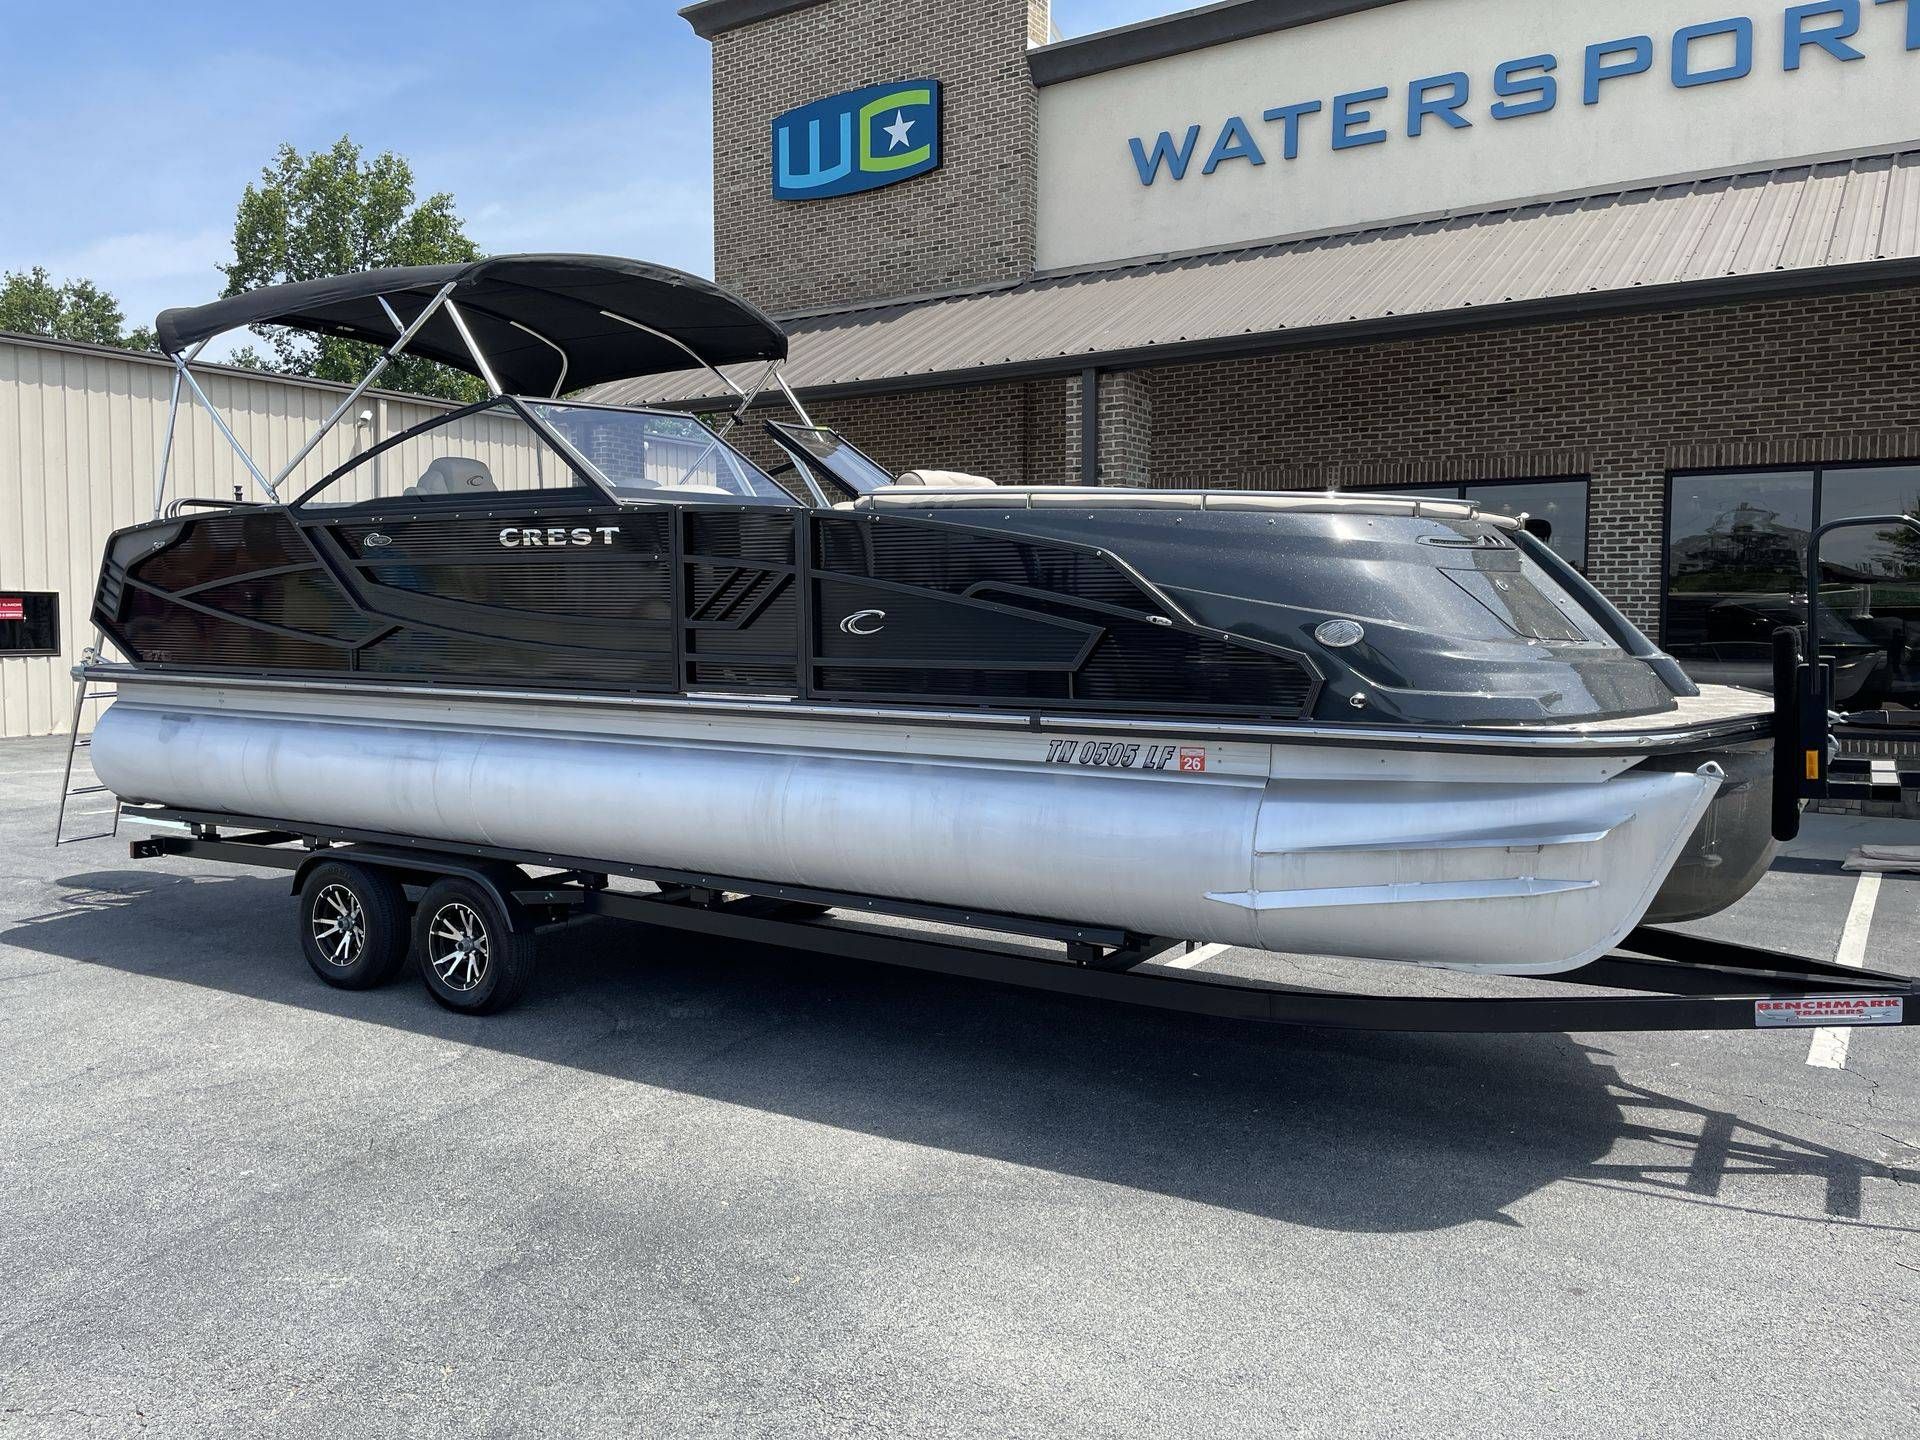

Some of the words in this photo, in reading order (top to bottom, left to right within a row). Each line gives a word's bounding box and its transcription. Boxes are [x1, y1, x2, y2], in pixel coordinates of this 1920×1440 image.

[778, 89, 931, 189] WC
[499, 526, 620, 547] CREST
[1046, 740, 1078, 763] TN
[1079, 741, 1140, 767] 0505
[1143, 745, 1176, 770] LF
[1184, 757, 1202, 770] 26
[1757, 1000, 1900, 1011] BENCHMARK
[1795, 1008, 1865, 1016] TRAILERS
